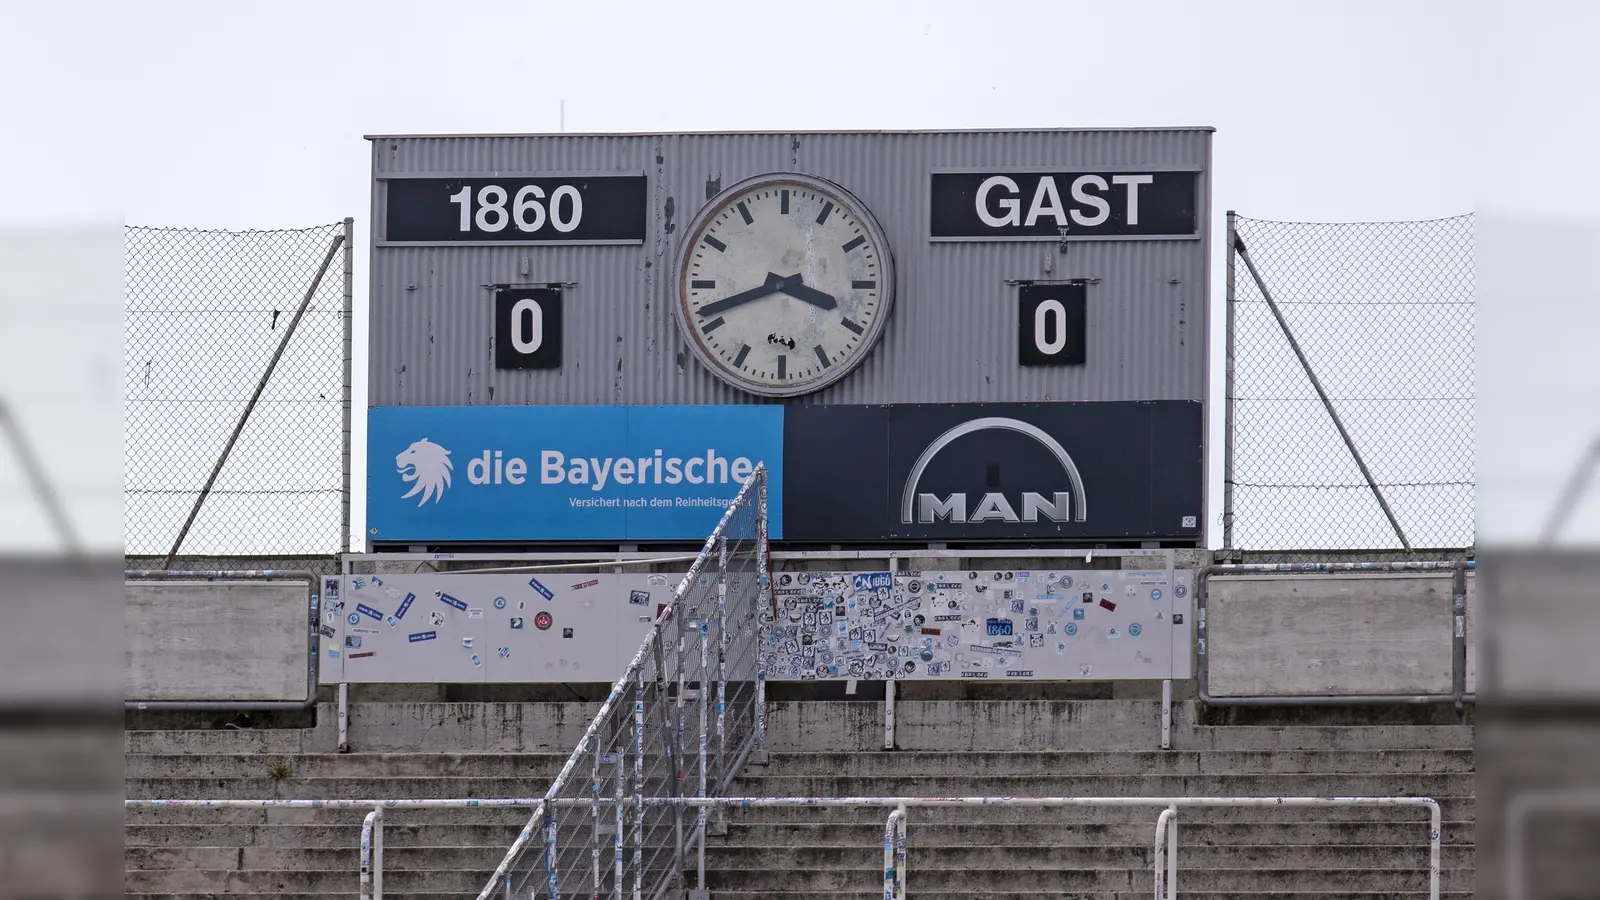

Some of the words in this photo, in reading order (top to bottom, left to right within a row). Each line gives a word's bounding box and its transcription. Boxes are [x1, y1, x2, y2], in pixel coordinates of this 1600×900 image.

[450, 185, 583, 232] 1860
[975, 174, 1153, 227] GAST
[511, 298, 543, 354] 0
[1034, 299, 1067, 355] 0
[467, 450, 527, 484] die
[541, 449, 753, 491] Bayerische
[569, 497, 620, 507] Versichert
[623, 497, 647, 507] nach
[650, 497, 673, 507] dem
[918, 492, 1070, 523] MAN
[988, 624, 1012, 636] 1860
